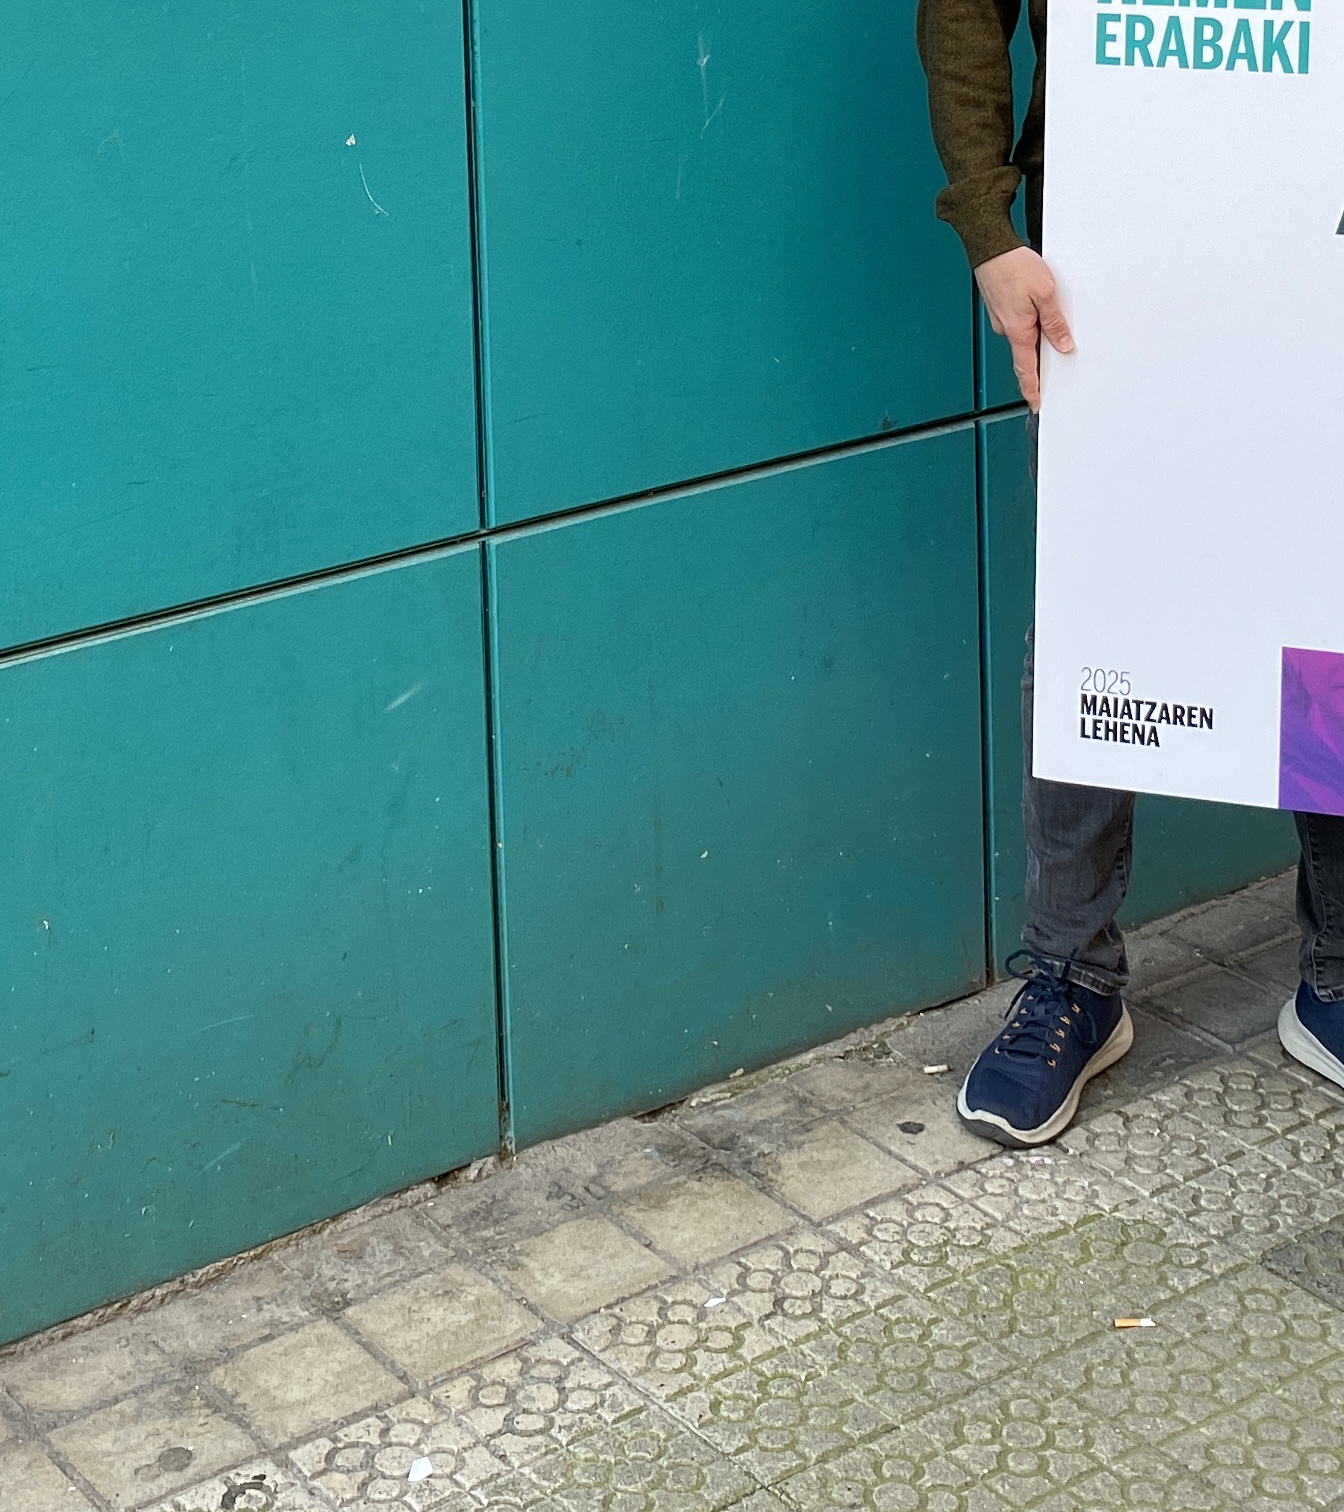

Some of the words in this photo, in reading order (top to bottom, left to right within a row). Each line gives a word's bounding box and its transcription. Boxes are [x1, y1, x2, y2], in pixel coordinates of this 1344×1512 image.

[1095, 13, 1311, 75] ERABAKI
[1080, 666, 1131, 696] 2025
[1080, 693, 1214, 730] MAIATZAREN
[1080, 717, 1160, 748] LEHENA
